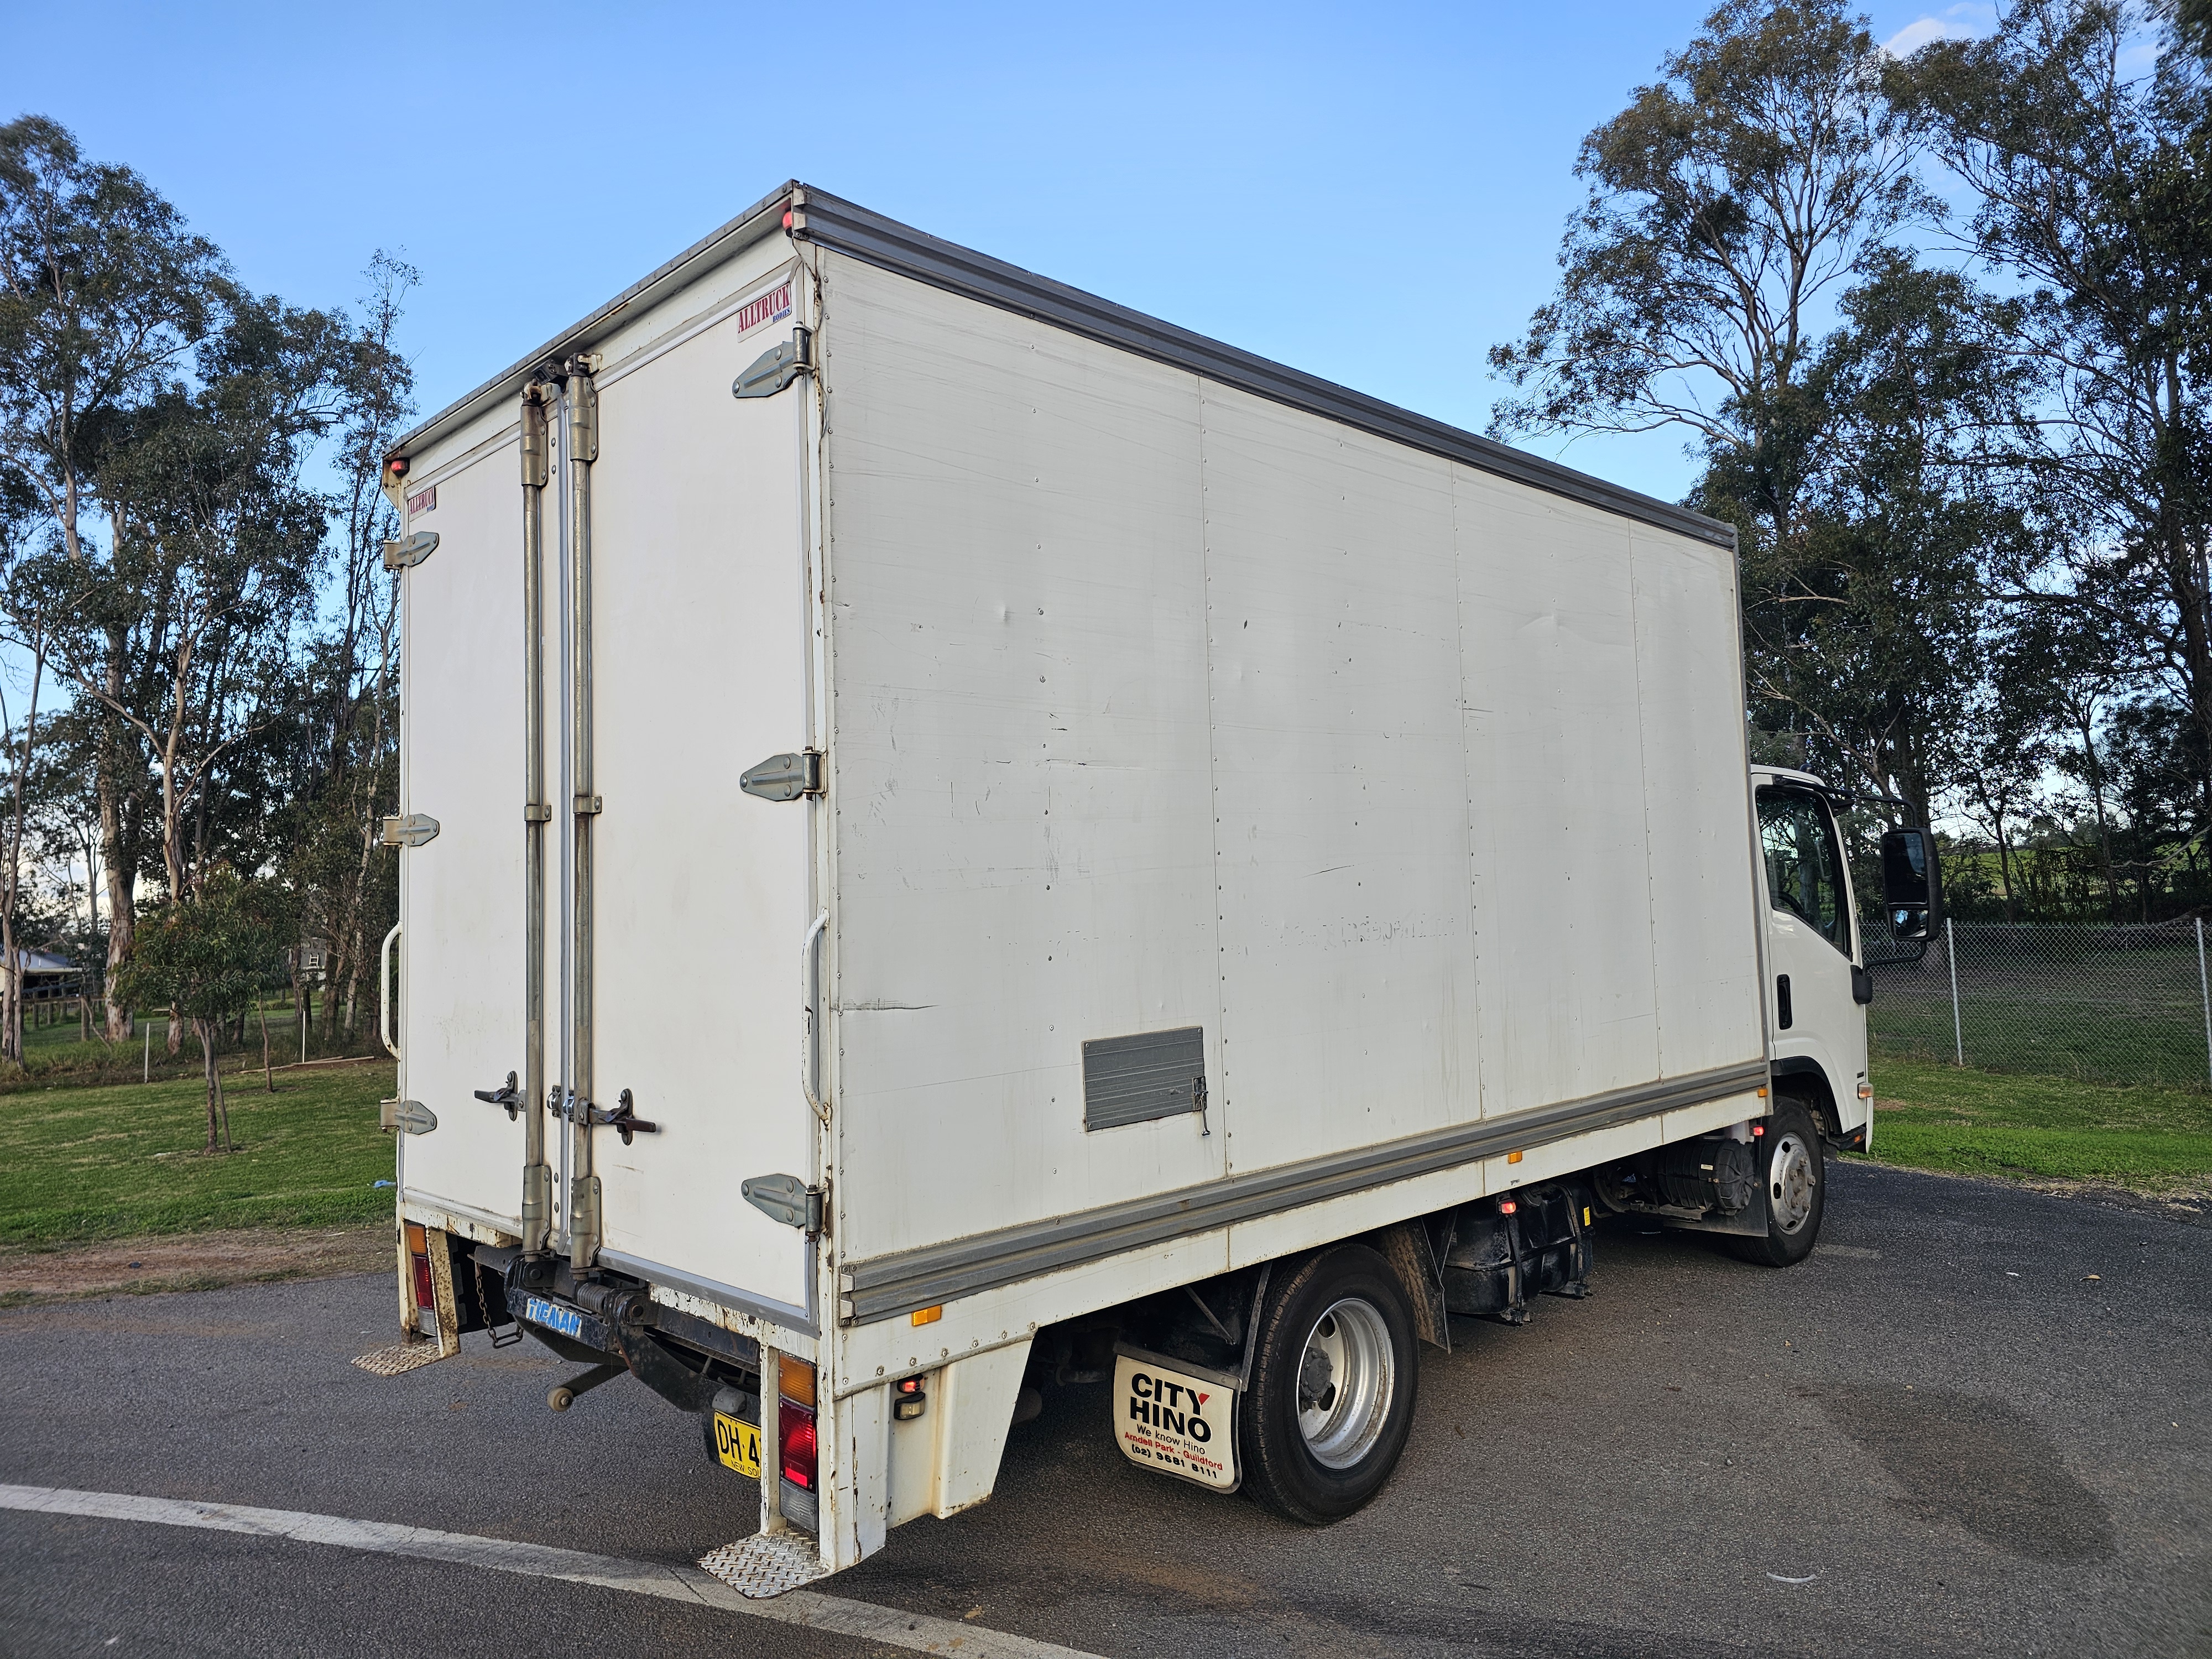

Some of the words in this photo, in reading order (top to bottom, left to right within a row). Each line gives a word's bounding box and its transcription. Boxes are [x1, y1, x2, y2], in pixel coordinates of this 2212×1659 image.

[738, 284, 790, 334] ALLTRUCK
[773, 307, 790, 323] BODIES
[1131, 1373, 1210, 1416] CITY
[1130, 1396, 1211, 1443] HINO
[1124, 1431, 1152, 1447] Arndell
[1155, 1441, 1175, 1454] Park
[1183, 1450, 1223, 1471] Guildford
[1136, 1423, 1152, 1437] We
[1155, 1430, 1180, 1446] know
[1184, 1439, 1206, 1455] Hino
[731, 1459, 745, 1472] NEW
[1131, 1443, 1151, 1458] (02)
[1156, 1452, 1185, 1468] 9681
[1192, 1463, 1217, 1479] 8111
